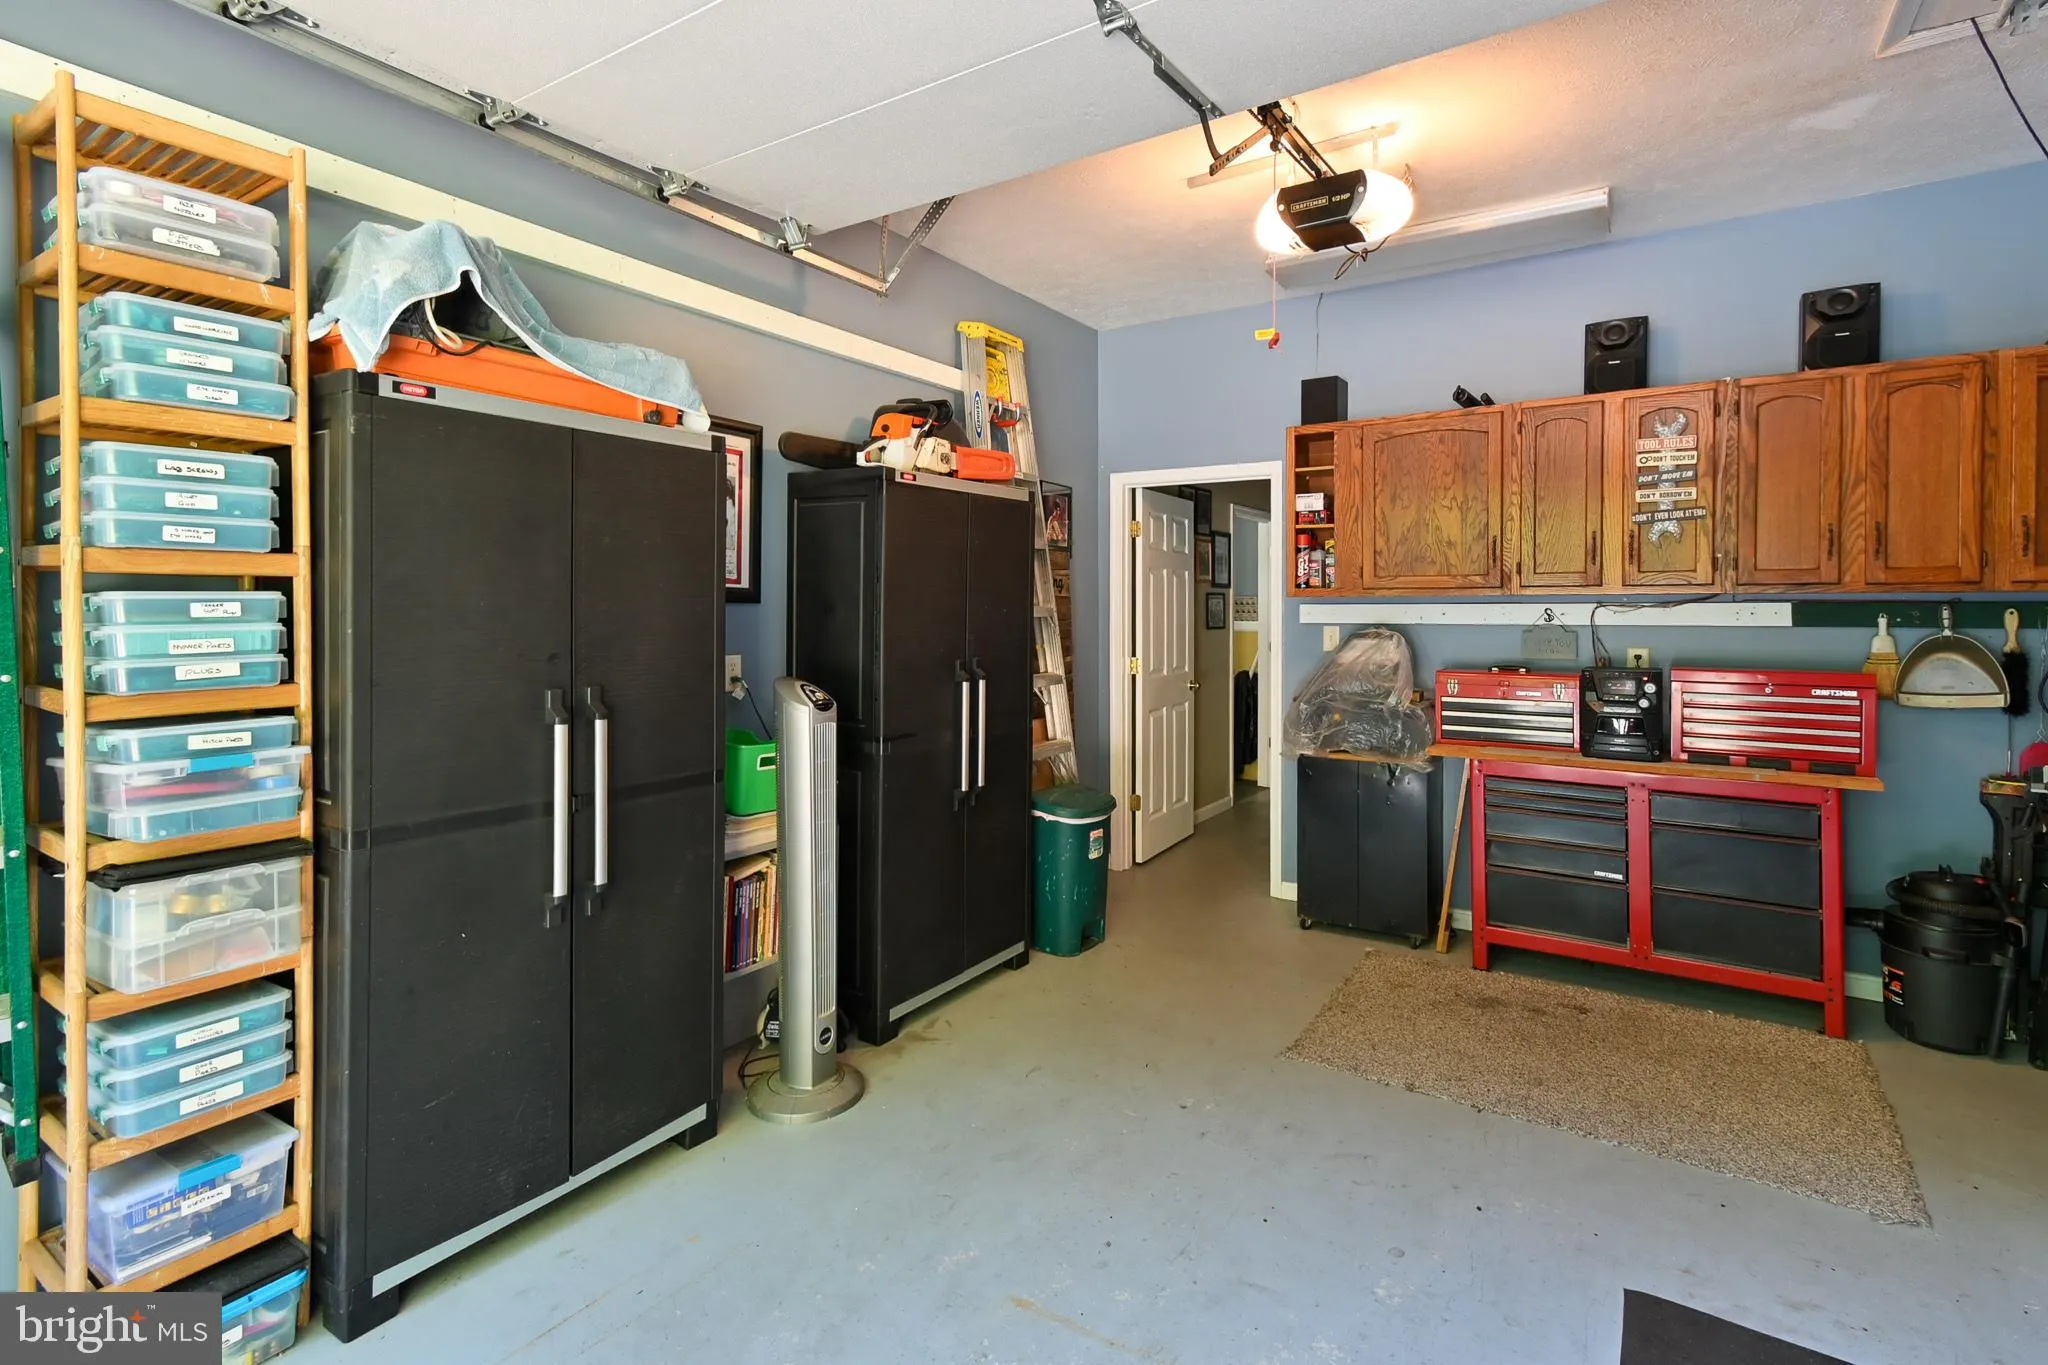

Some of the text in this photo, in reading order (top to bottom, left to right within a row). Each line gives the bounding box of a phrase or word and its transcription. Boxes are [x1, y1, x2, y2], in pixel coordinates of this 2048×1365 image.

[1293, 198, 1326, 210] CRAFTSMAN
[1638, 437, 1694, 450] TOOL RULES
[1653, 455, 1667, 463] DON'T
[1638, 474, 1658, 482] DON'T
[1635, 513, 1651, 521] DON'T
[1655, 511, 1668, 519] EVEN
[1670, 509, 1684, 517] LOOK
[185, 667, 222, 678] PLUGS
[1811, 688, 1858, 697] CRAFTSMAN
